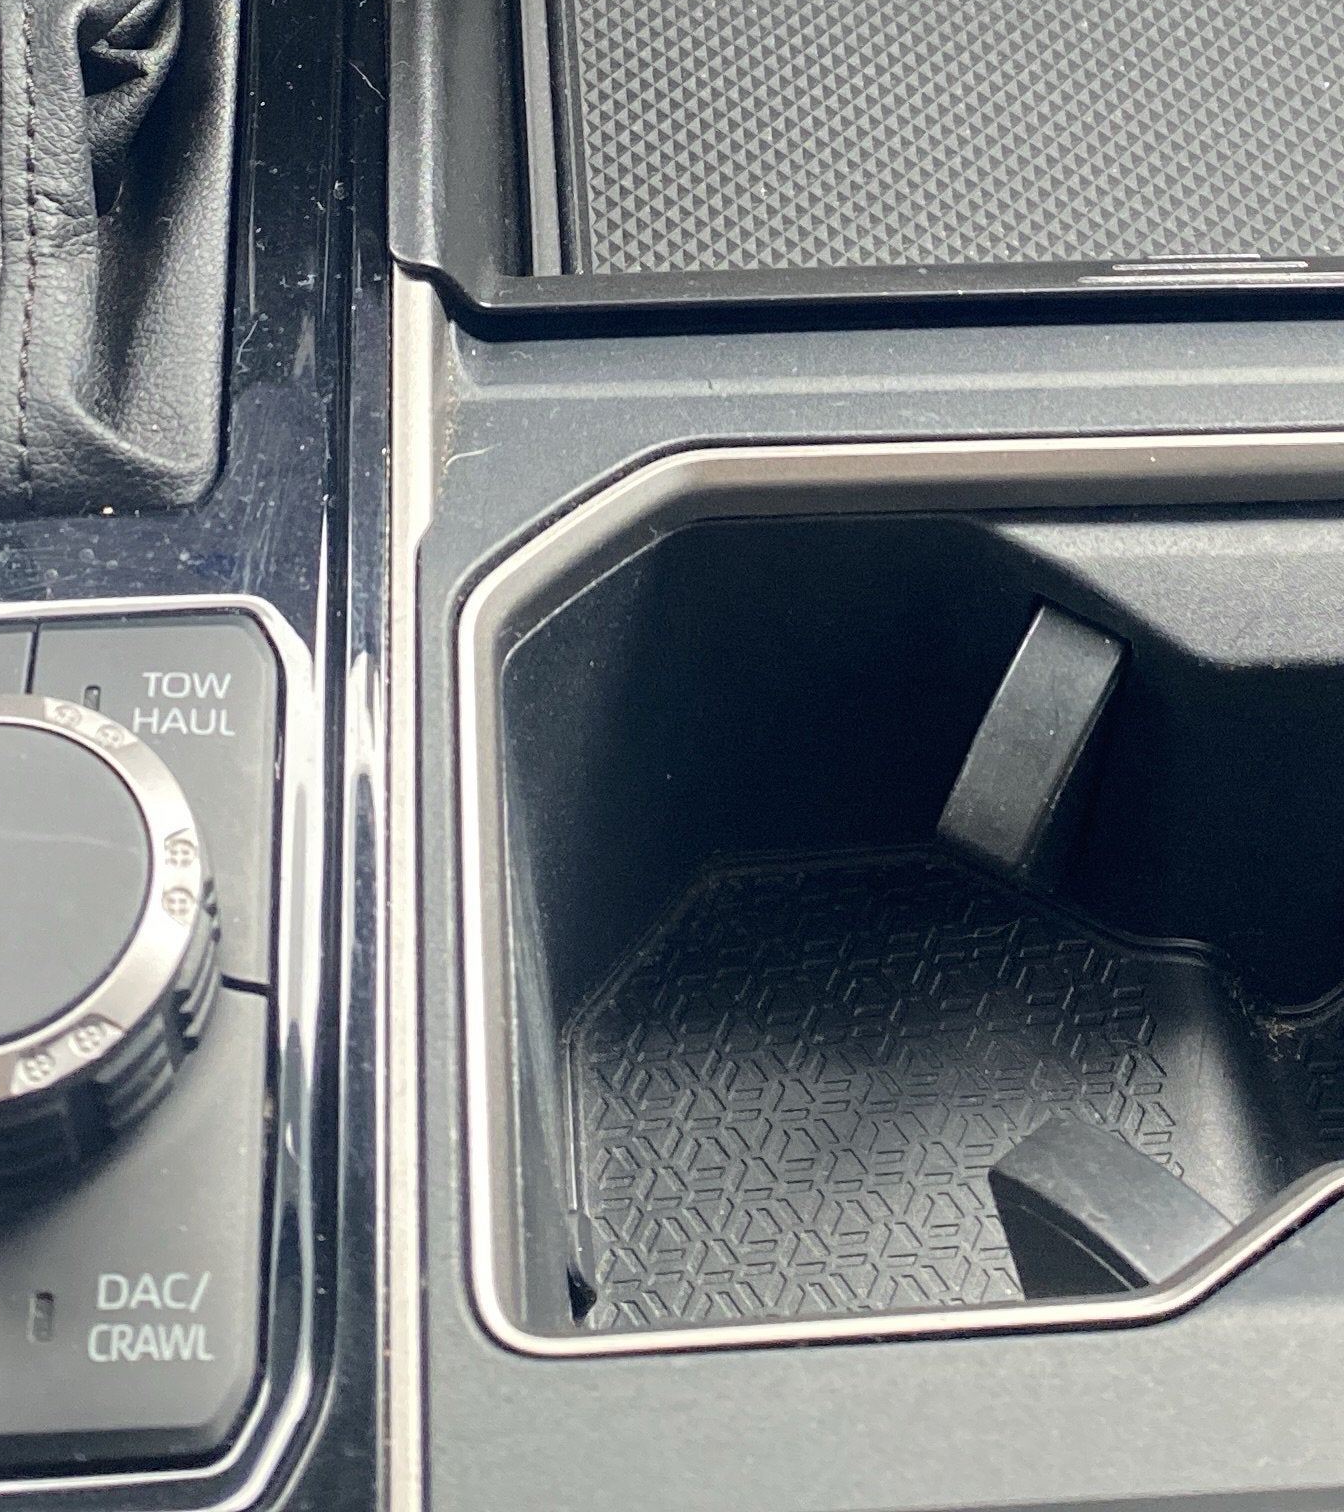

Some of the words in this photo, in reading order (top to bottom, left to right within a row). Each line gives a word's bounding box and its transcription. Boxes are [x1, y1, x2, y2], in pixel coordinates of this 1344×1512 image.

[141, 672, 232, 699] TOW
[133, 707, 236, 736] HAUL
[96, 1271, 212, 1312] DAC/
[87, 1323, 215, 1363] CRAWL
